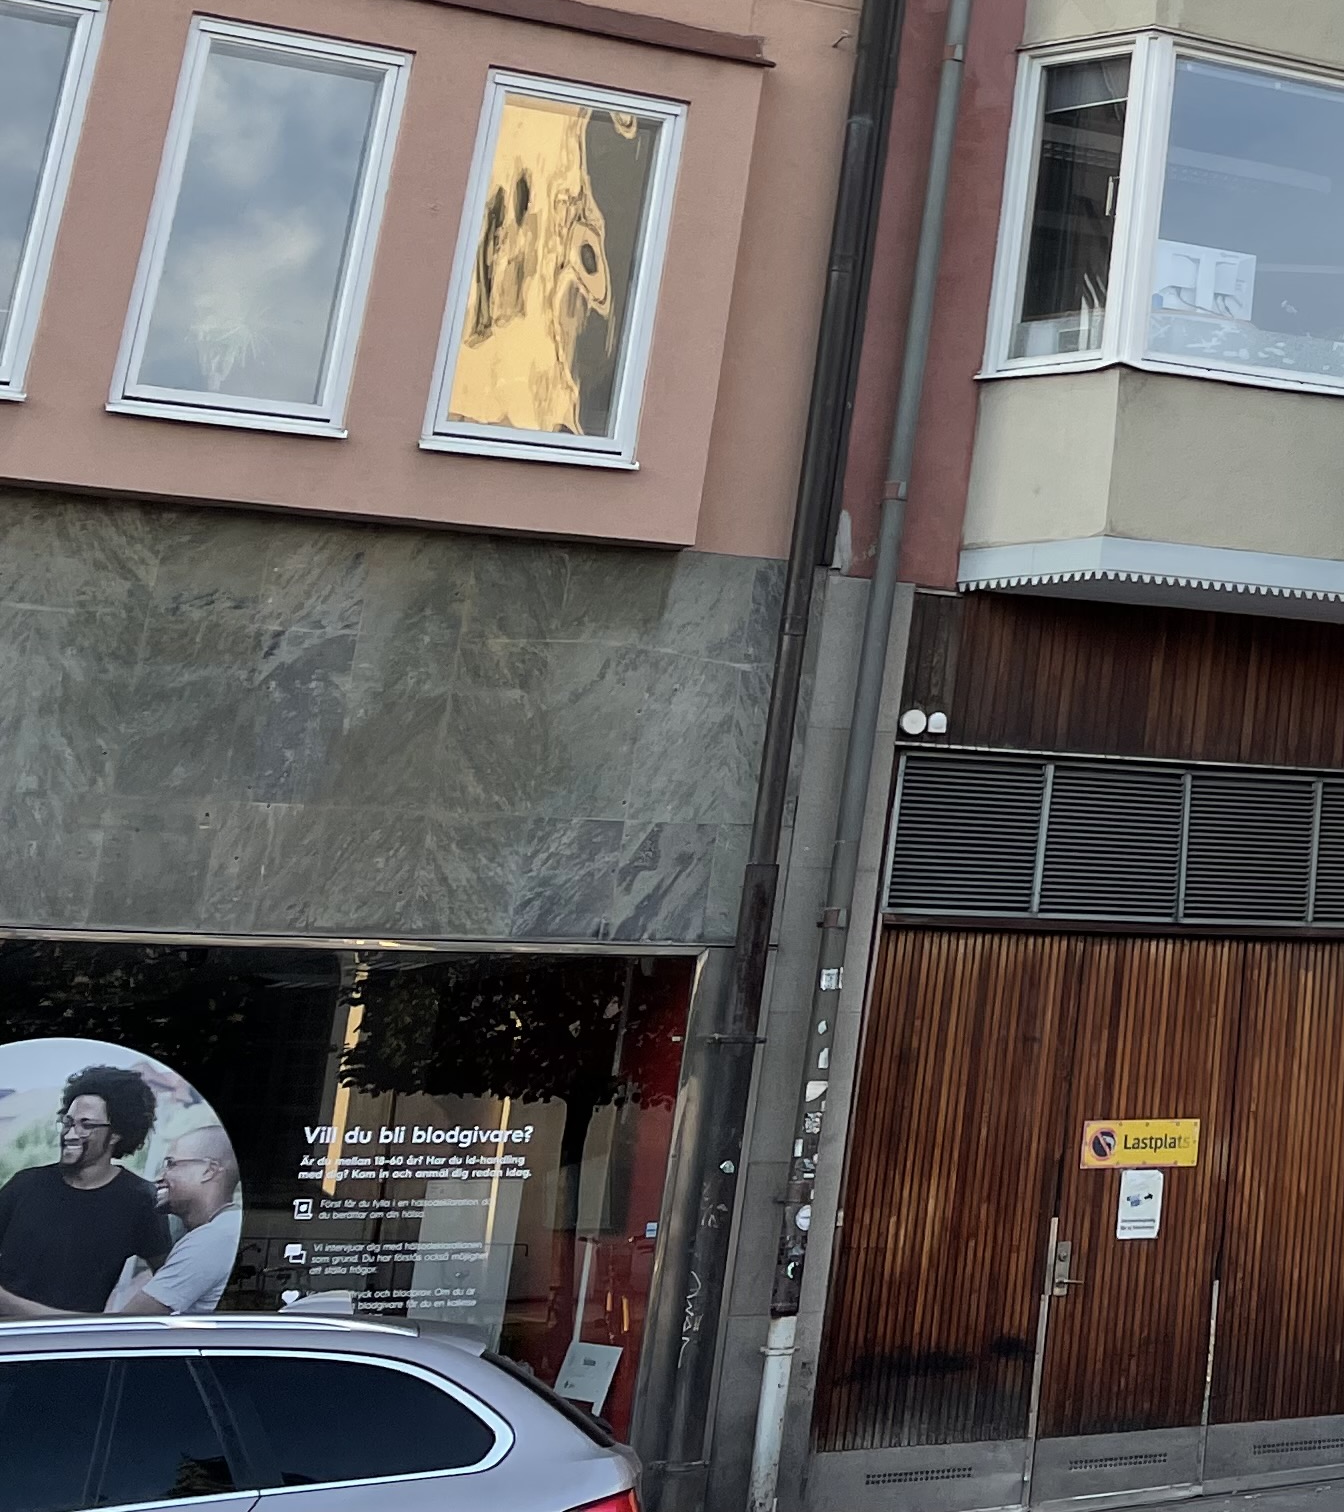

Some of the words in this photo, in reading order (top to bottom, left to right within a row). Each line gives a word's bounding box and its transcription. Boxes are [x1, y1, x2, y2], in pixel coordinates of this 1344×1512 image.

[303, 1126, 337, 1144] Vill
[344, 1126, 372, 1144] du
[379, 1126, 407, 1144] bli
[412, 1125, 534, 1148] blodgivare?
[1123, 1133, 1191, 1153] Lastplats
[300, 1155, 314, 1167] Är
[317, 1156, 331, 1166] du
[334, 1156, 371, 1167] mellan
[374, 1156, 403, 1166] 18-60
[426, 1156, 446, 1166] Har
[448, 1156, 462, 1166] du
[465, 1155, 525, 1168] id-handling
[298, 1169, 322, 1179] med
[325, 1169, 349, 1181] dig?
[352, 1169, 376, 1179] Kom
[378, 1168, 389, 1179] in
[392, 1168, 412, 1179] och
[415, 1168, 449, 1179] anmäl
[451, 1168, 469, 1180] dig
[471, 1168, 503, 1179] redan
[505, 1168, 532, 1180] idag.
